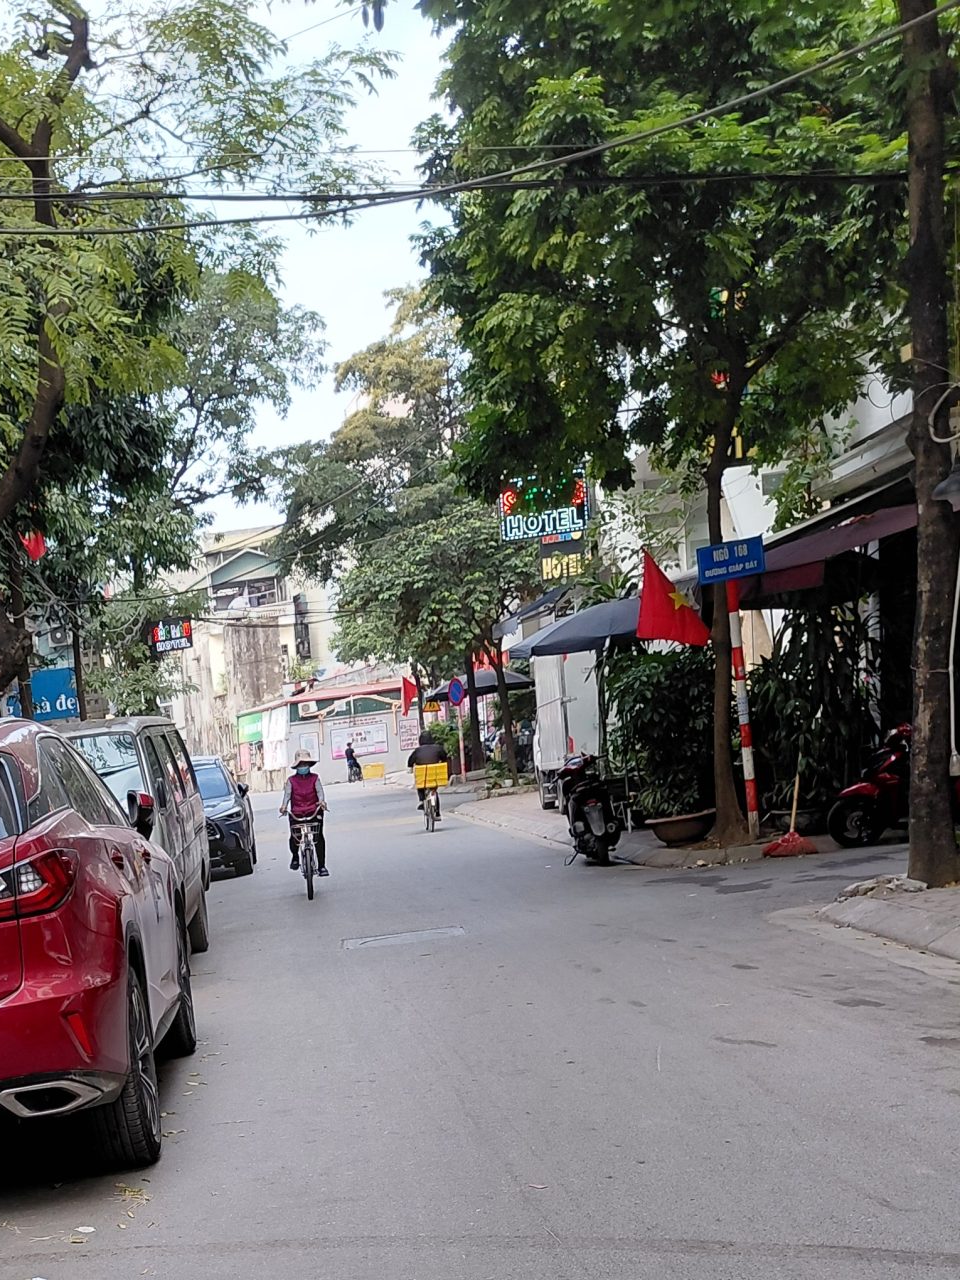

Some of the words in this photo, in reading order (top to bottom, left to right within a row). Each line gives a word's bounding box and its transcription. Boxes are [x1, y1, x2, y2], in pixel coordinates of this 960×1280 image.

[506, 507, 583, 537] HOTEL
[734, 544, 747, 557] 168
[542, 553, 584, 580] HOTEL
[156, 637, 191, 652] HOTEL
